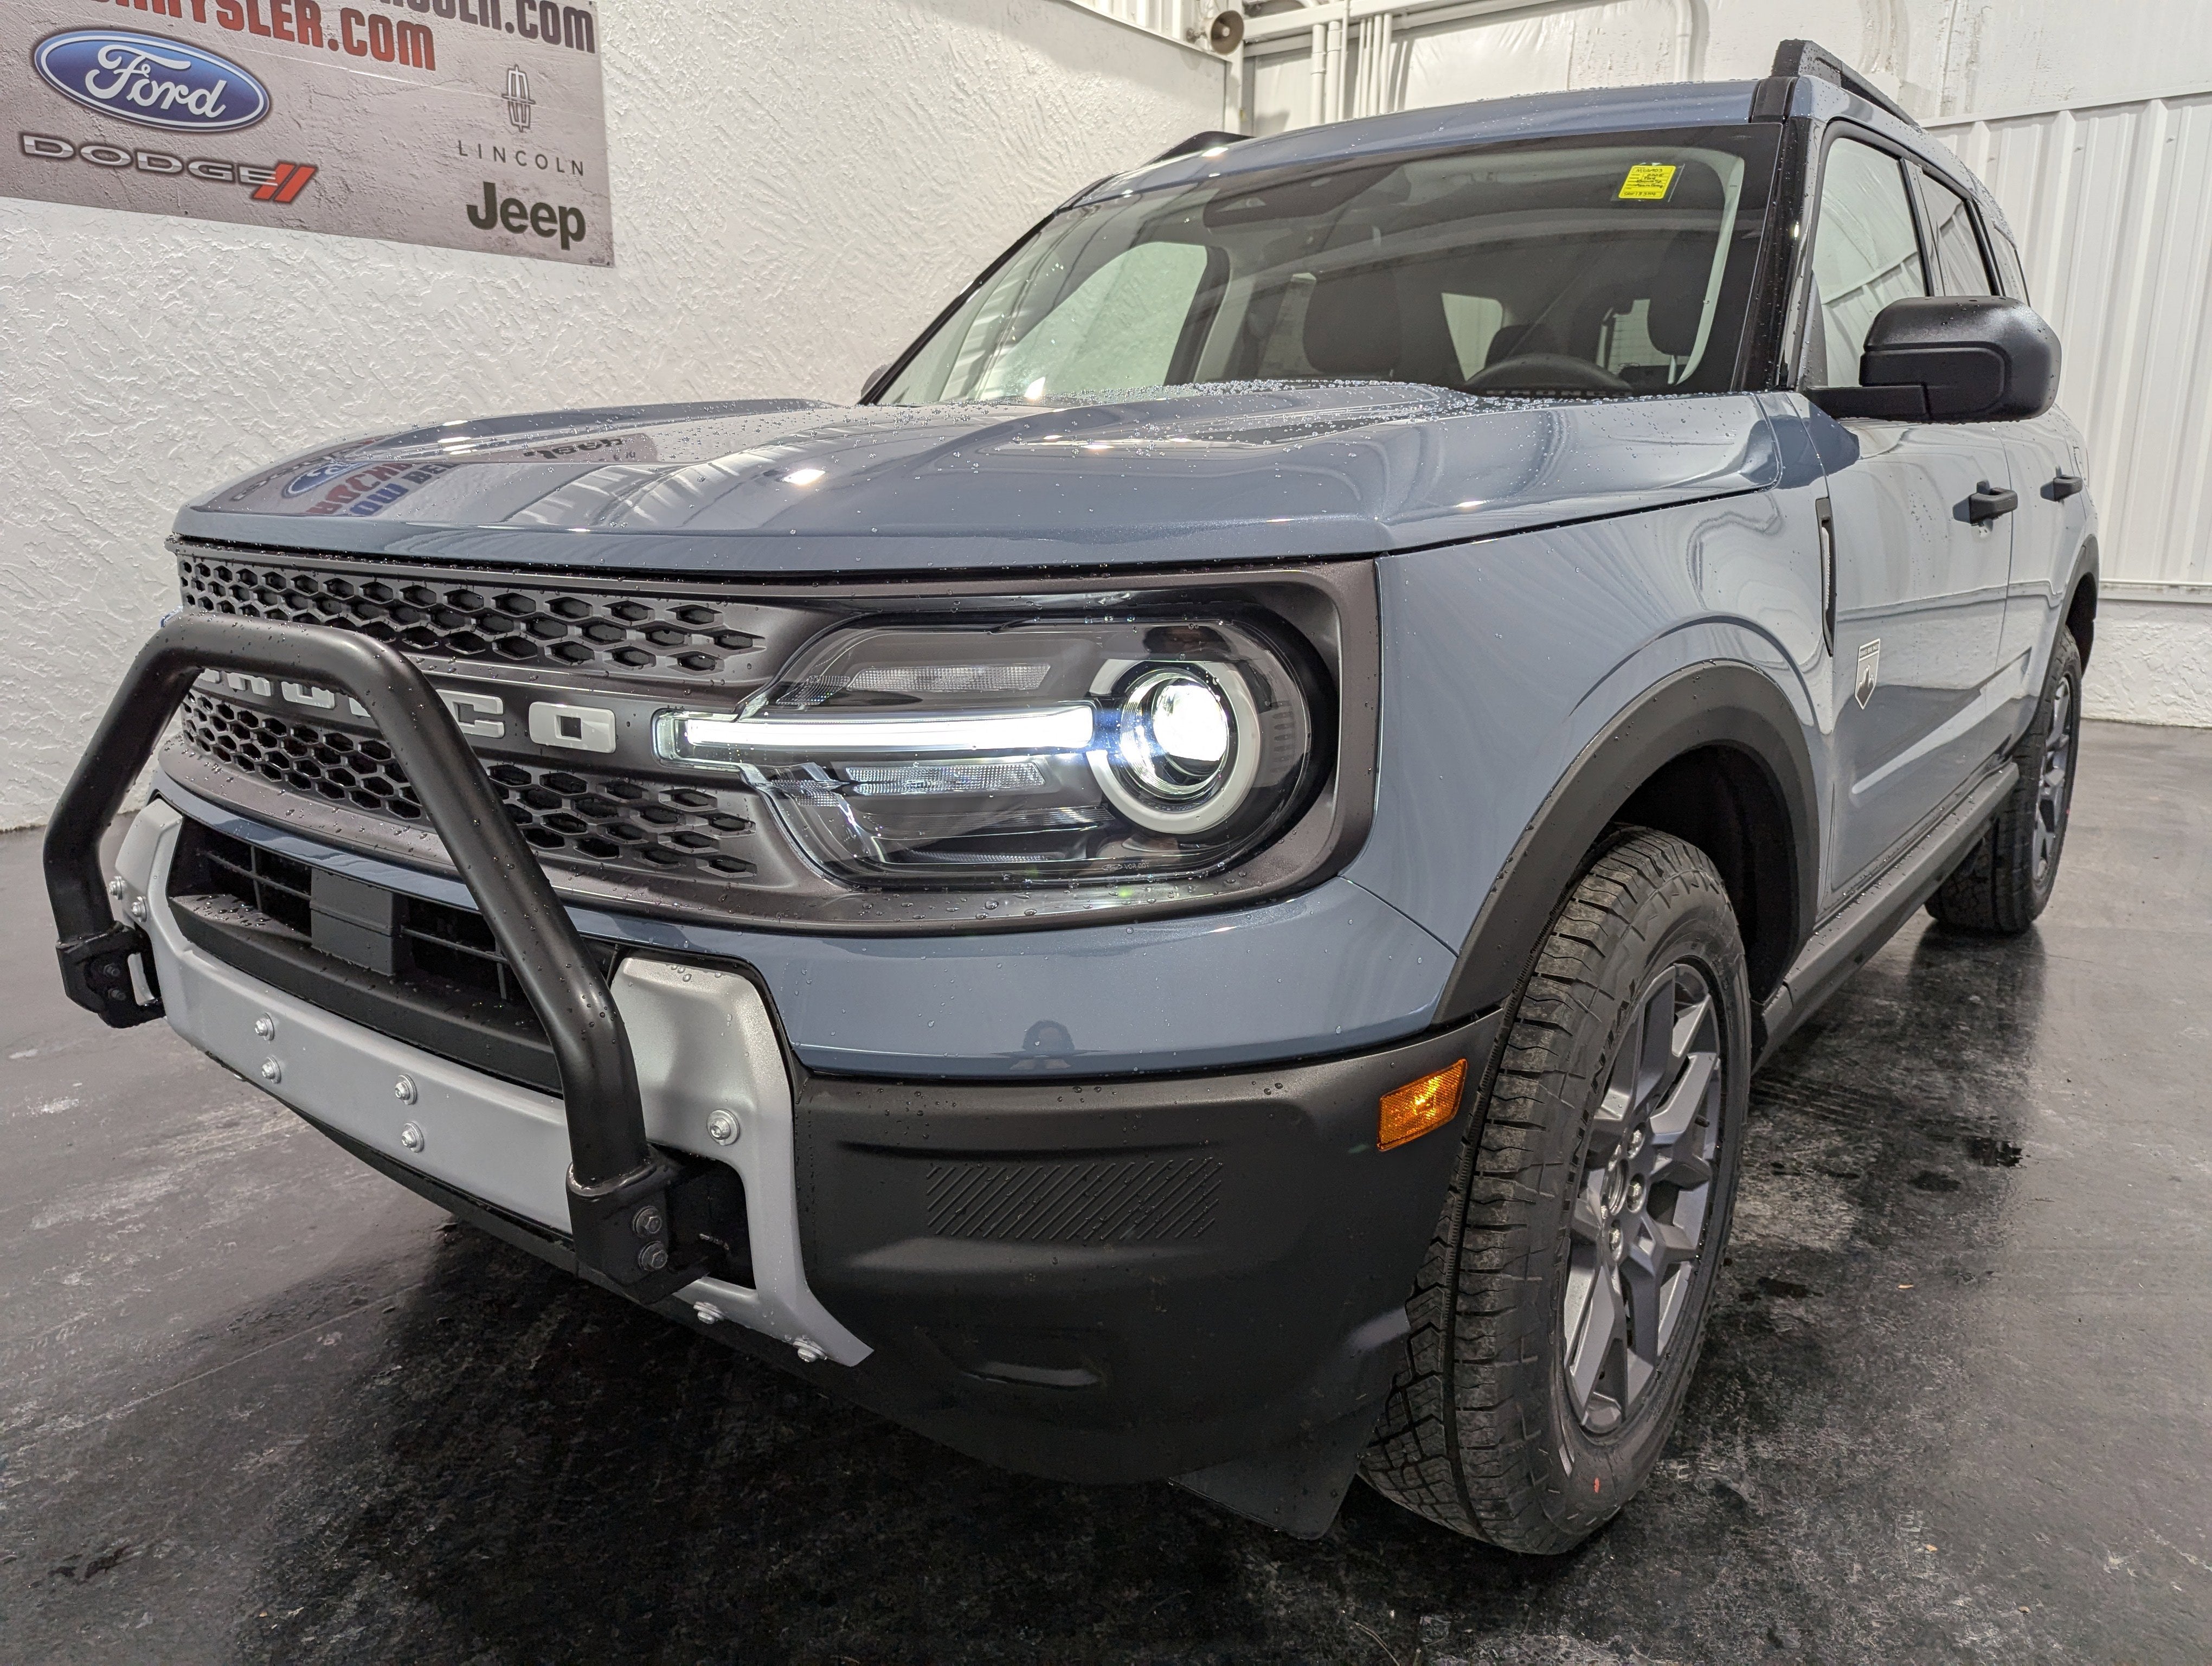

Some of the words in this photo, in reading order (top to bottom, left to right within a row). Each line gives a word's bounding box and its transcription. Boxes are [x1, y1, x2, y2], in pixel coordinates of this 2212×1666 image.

[91, 0, 435, 71] YSLER.COM
[372, 0, 595, 54] LN.COM
[85, 44, 227, 118] Ford
[22, 134, 279, 187] DODGE
[458, 139, 584, 176] LINCOLN
[466, 181, 586, 251] Jeep
[1860, 649, 1868, 657] BIG
[1868, 643, 1879, 653] BEND
